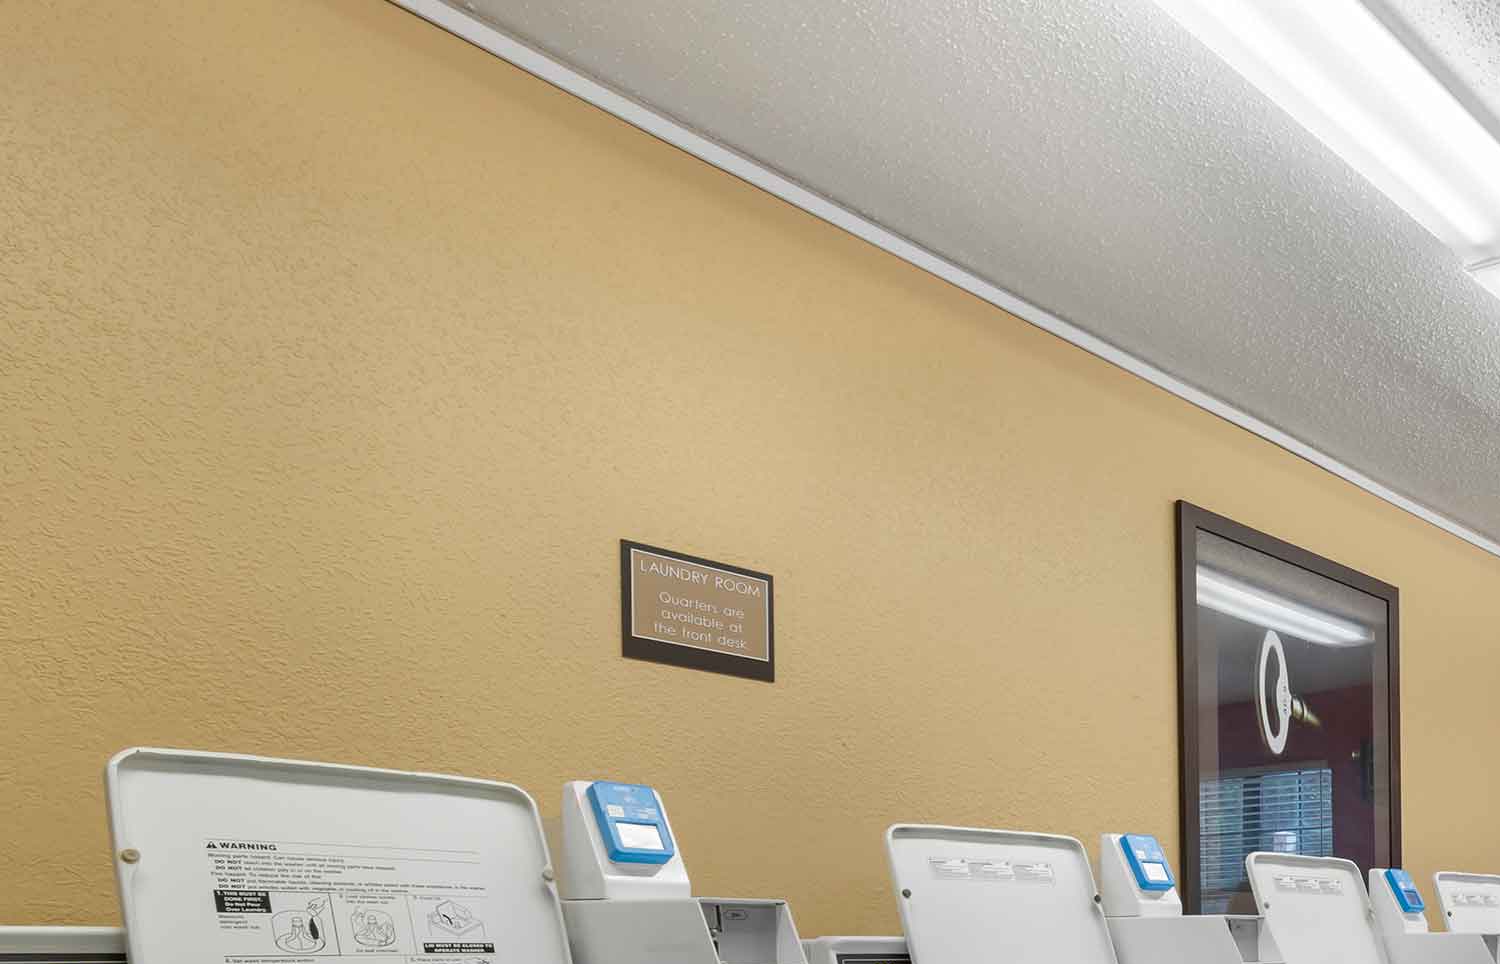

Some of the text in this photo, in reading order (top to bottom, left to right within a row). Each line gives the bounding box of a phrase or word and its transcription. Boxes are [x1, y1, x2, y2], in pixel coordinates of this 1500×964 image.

[639, 559, 761, 598] LAUNDRY ROOM
[659, 591, 745, 619] Quarters are
[661, 610, 743, 633] available at
[654, 622, 747, 649] the front desk
[219, 842, 278, 851] WARNING
